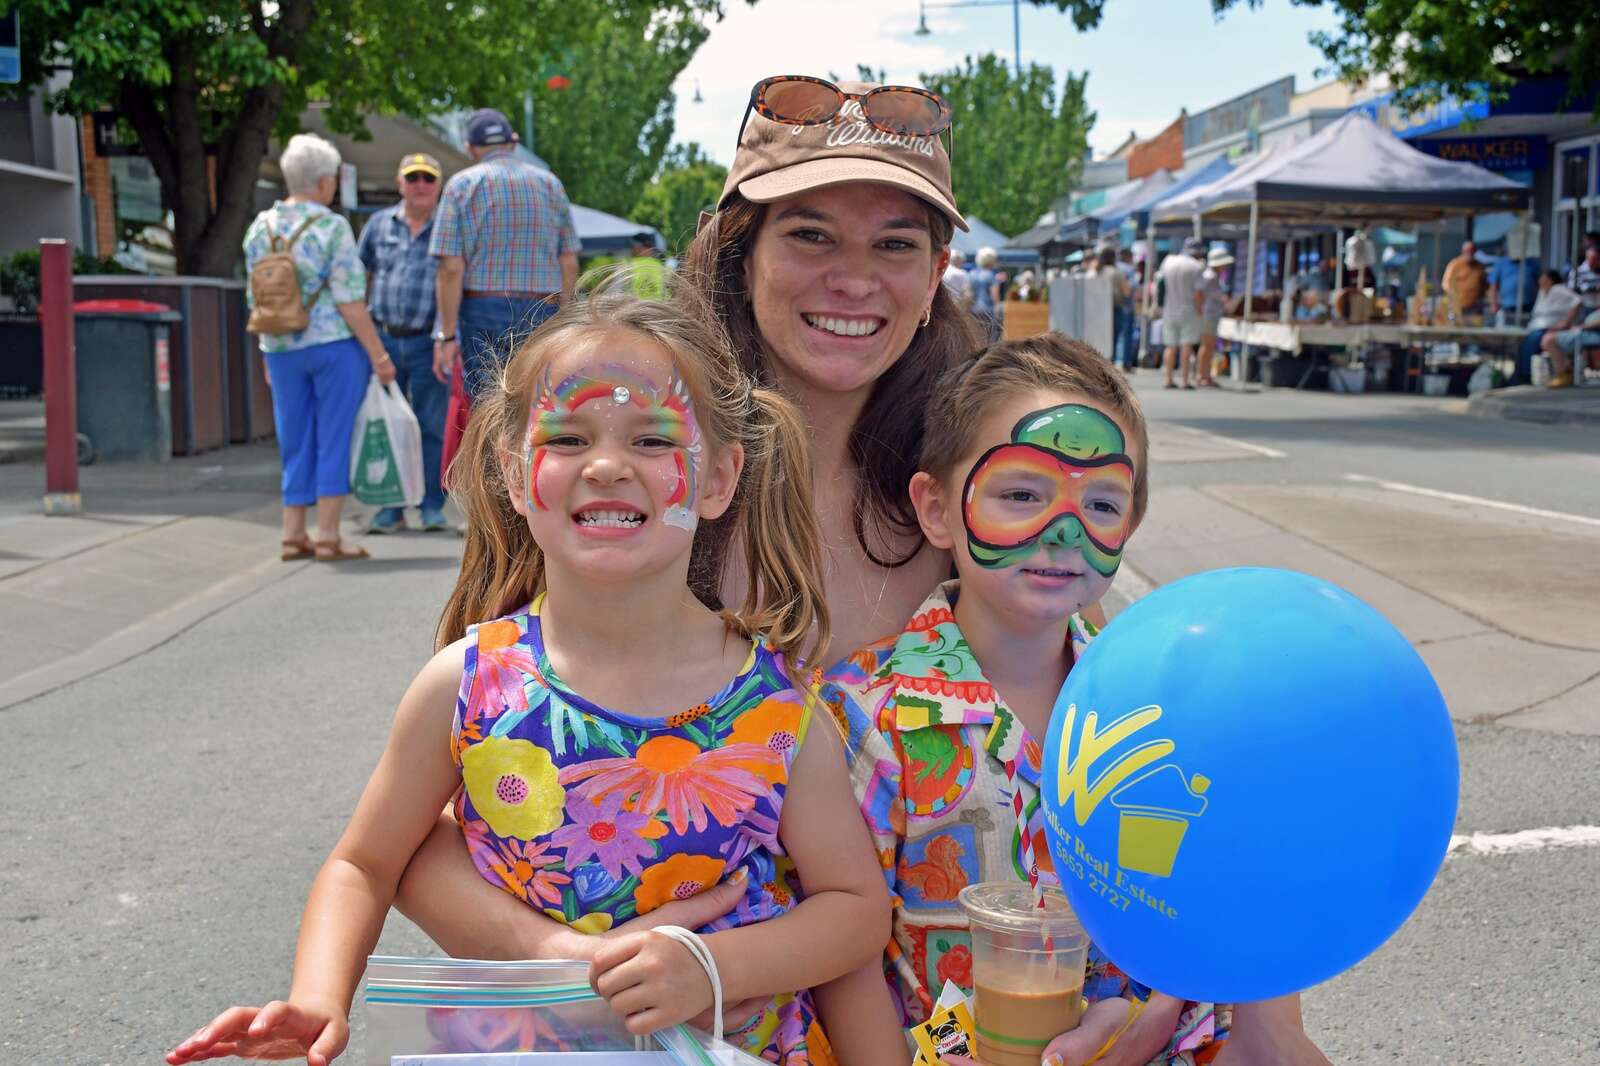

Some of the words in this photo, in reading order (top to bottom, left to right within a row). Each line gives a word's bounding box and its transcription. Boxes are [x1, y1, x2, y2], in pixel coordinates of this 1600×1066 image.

[1056, 840, 1084, 880] 5853
[1088, 872, 1131, 913] 2727
[1075, 835, 1109, 879] Real
[1115, 870, 1178, 919] Estate
